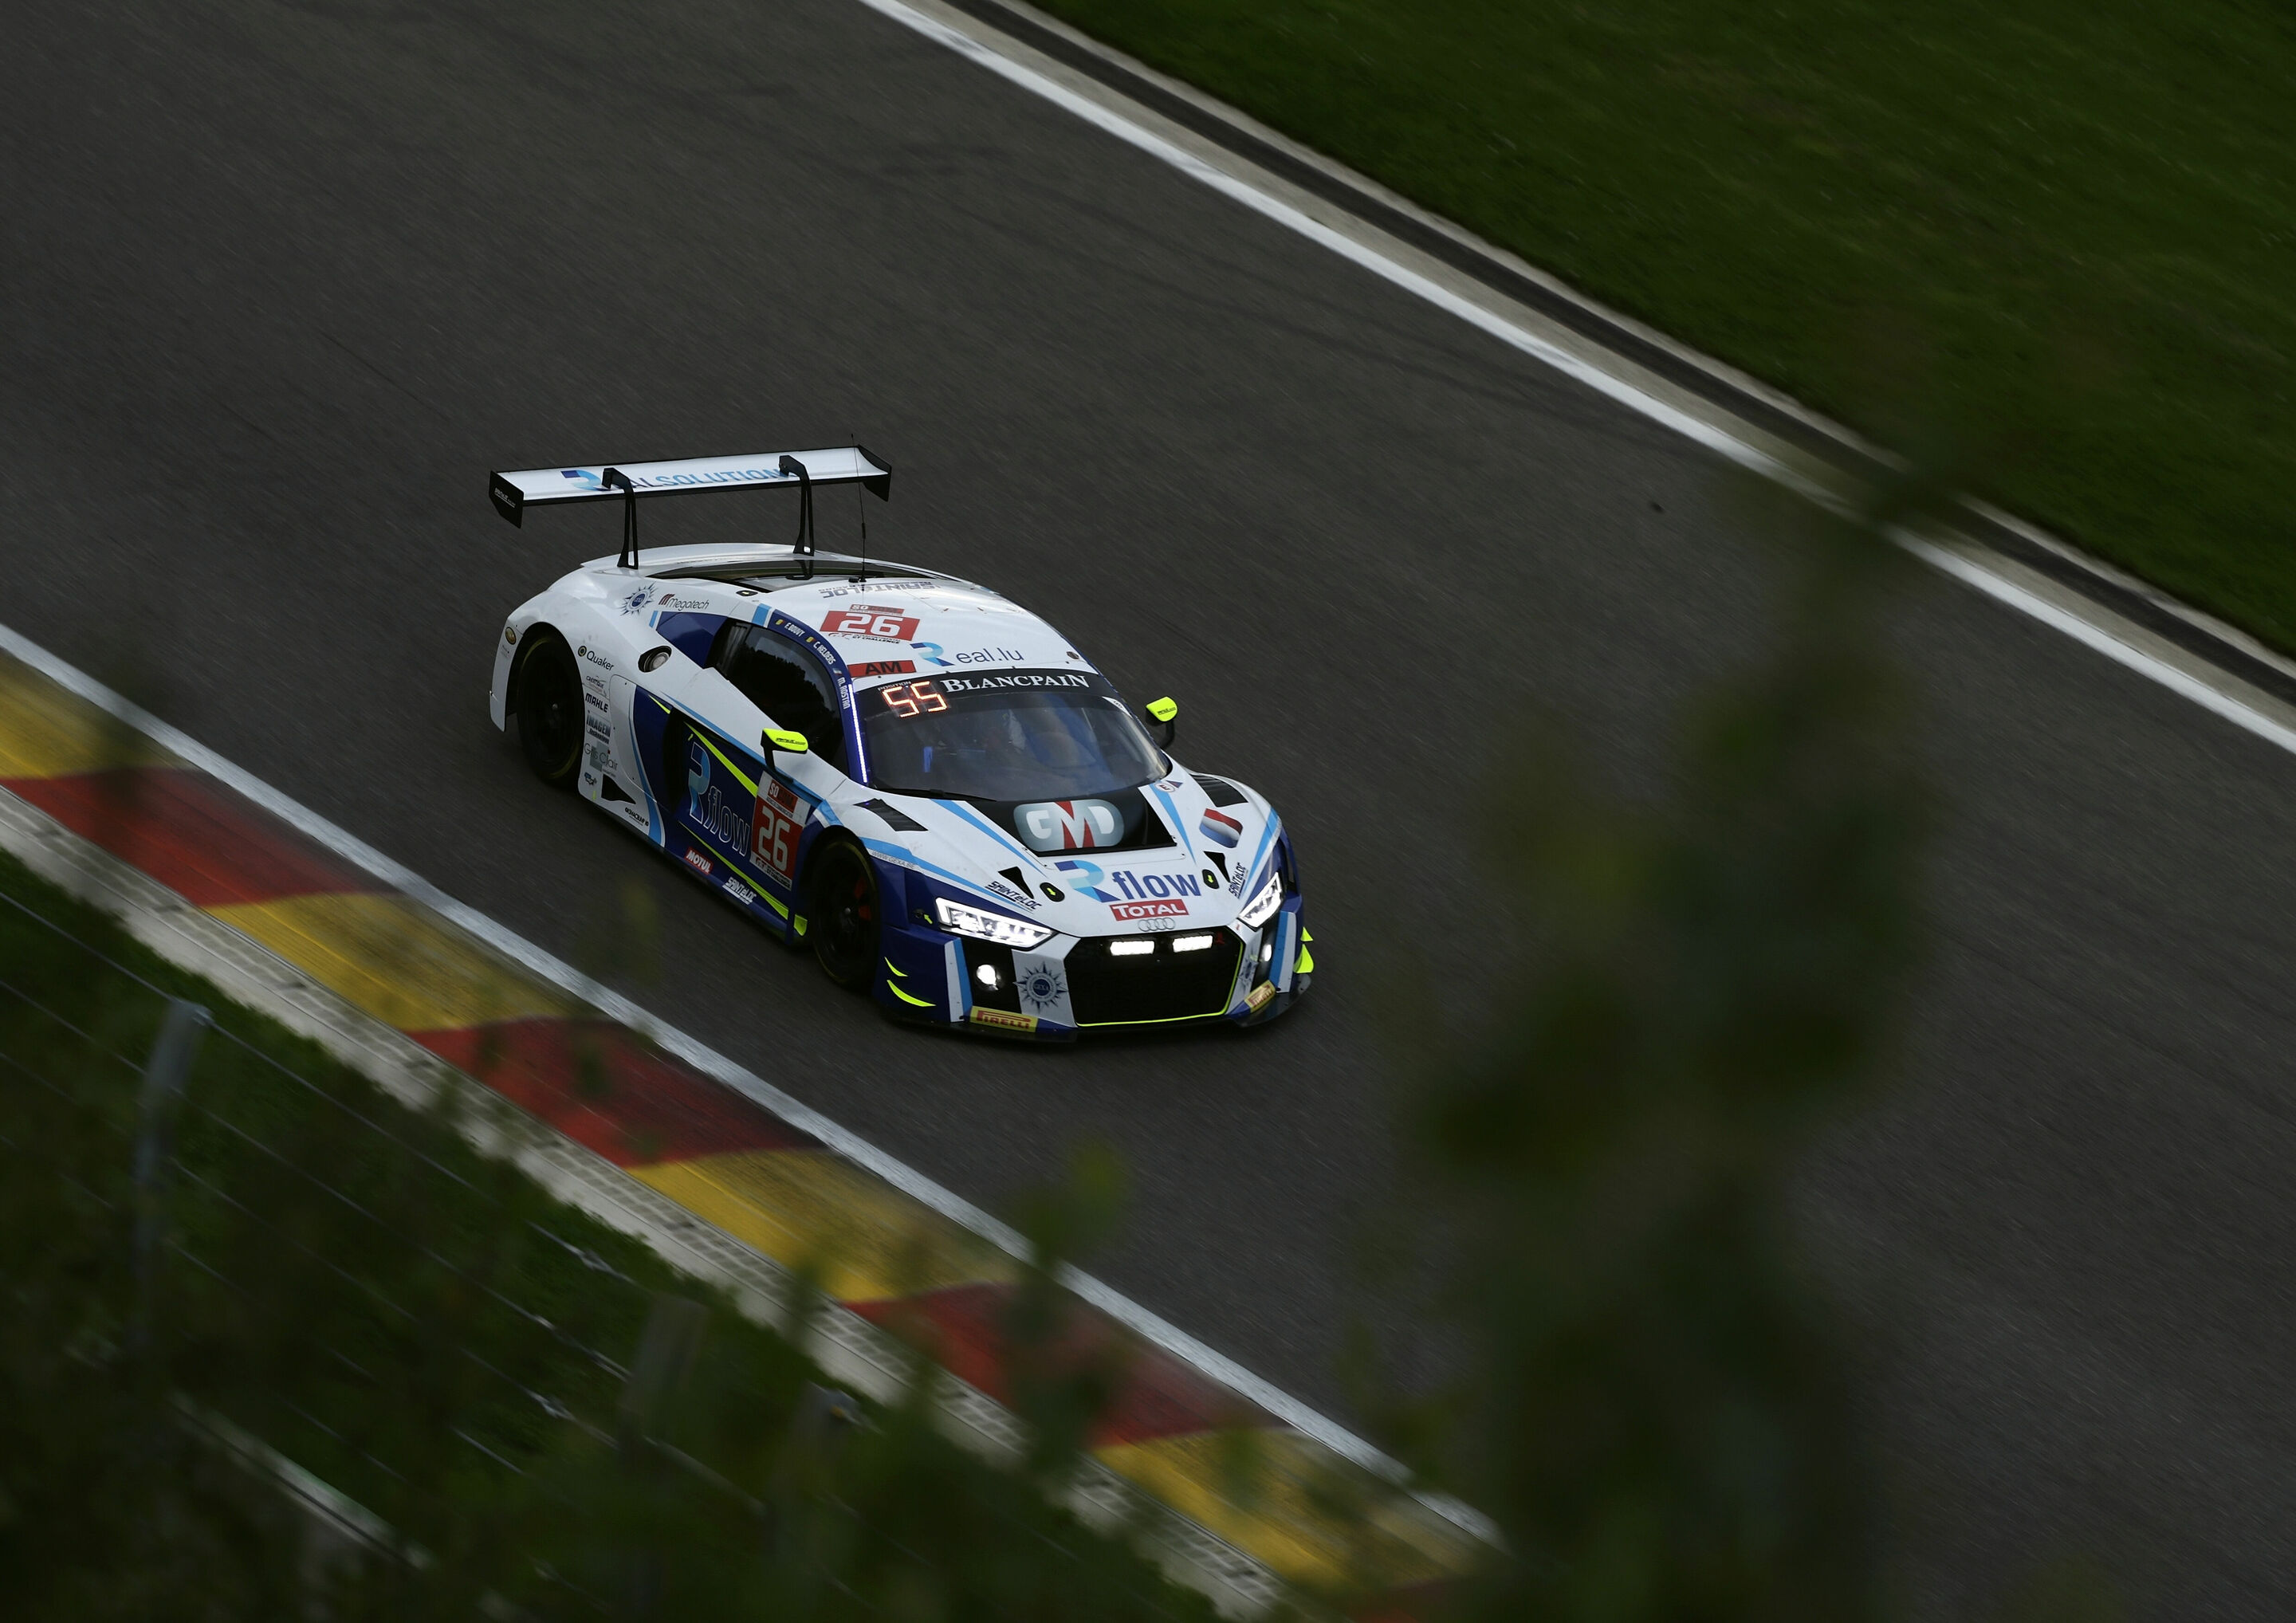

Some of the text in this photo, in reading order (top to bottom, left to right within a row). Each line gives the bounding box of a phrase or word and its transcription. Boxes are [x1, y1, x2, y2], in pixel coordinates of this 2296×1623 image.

[837, 613, 904, 637] 26
[586, 650, 615, 671] Quaker
[865, 662, 902, 674] AM
[585, 693, 609, 713] MAHLE
[882, 681, 949, 717] 55
[757, 805, 792, 872] 26
[686, 850, 712, 873] MOTUL
[1112, 904, 1187, 918] TOTAL
[976, 1010, 1032, 1030] PIRELLI
